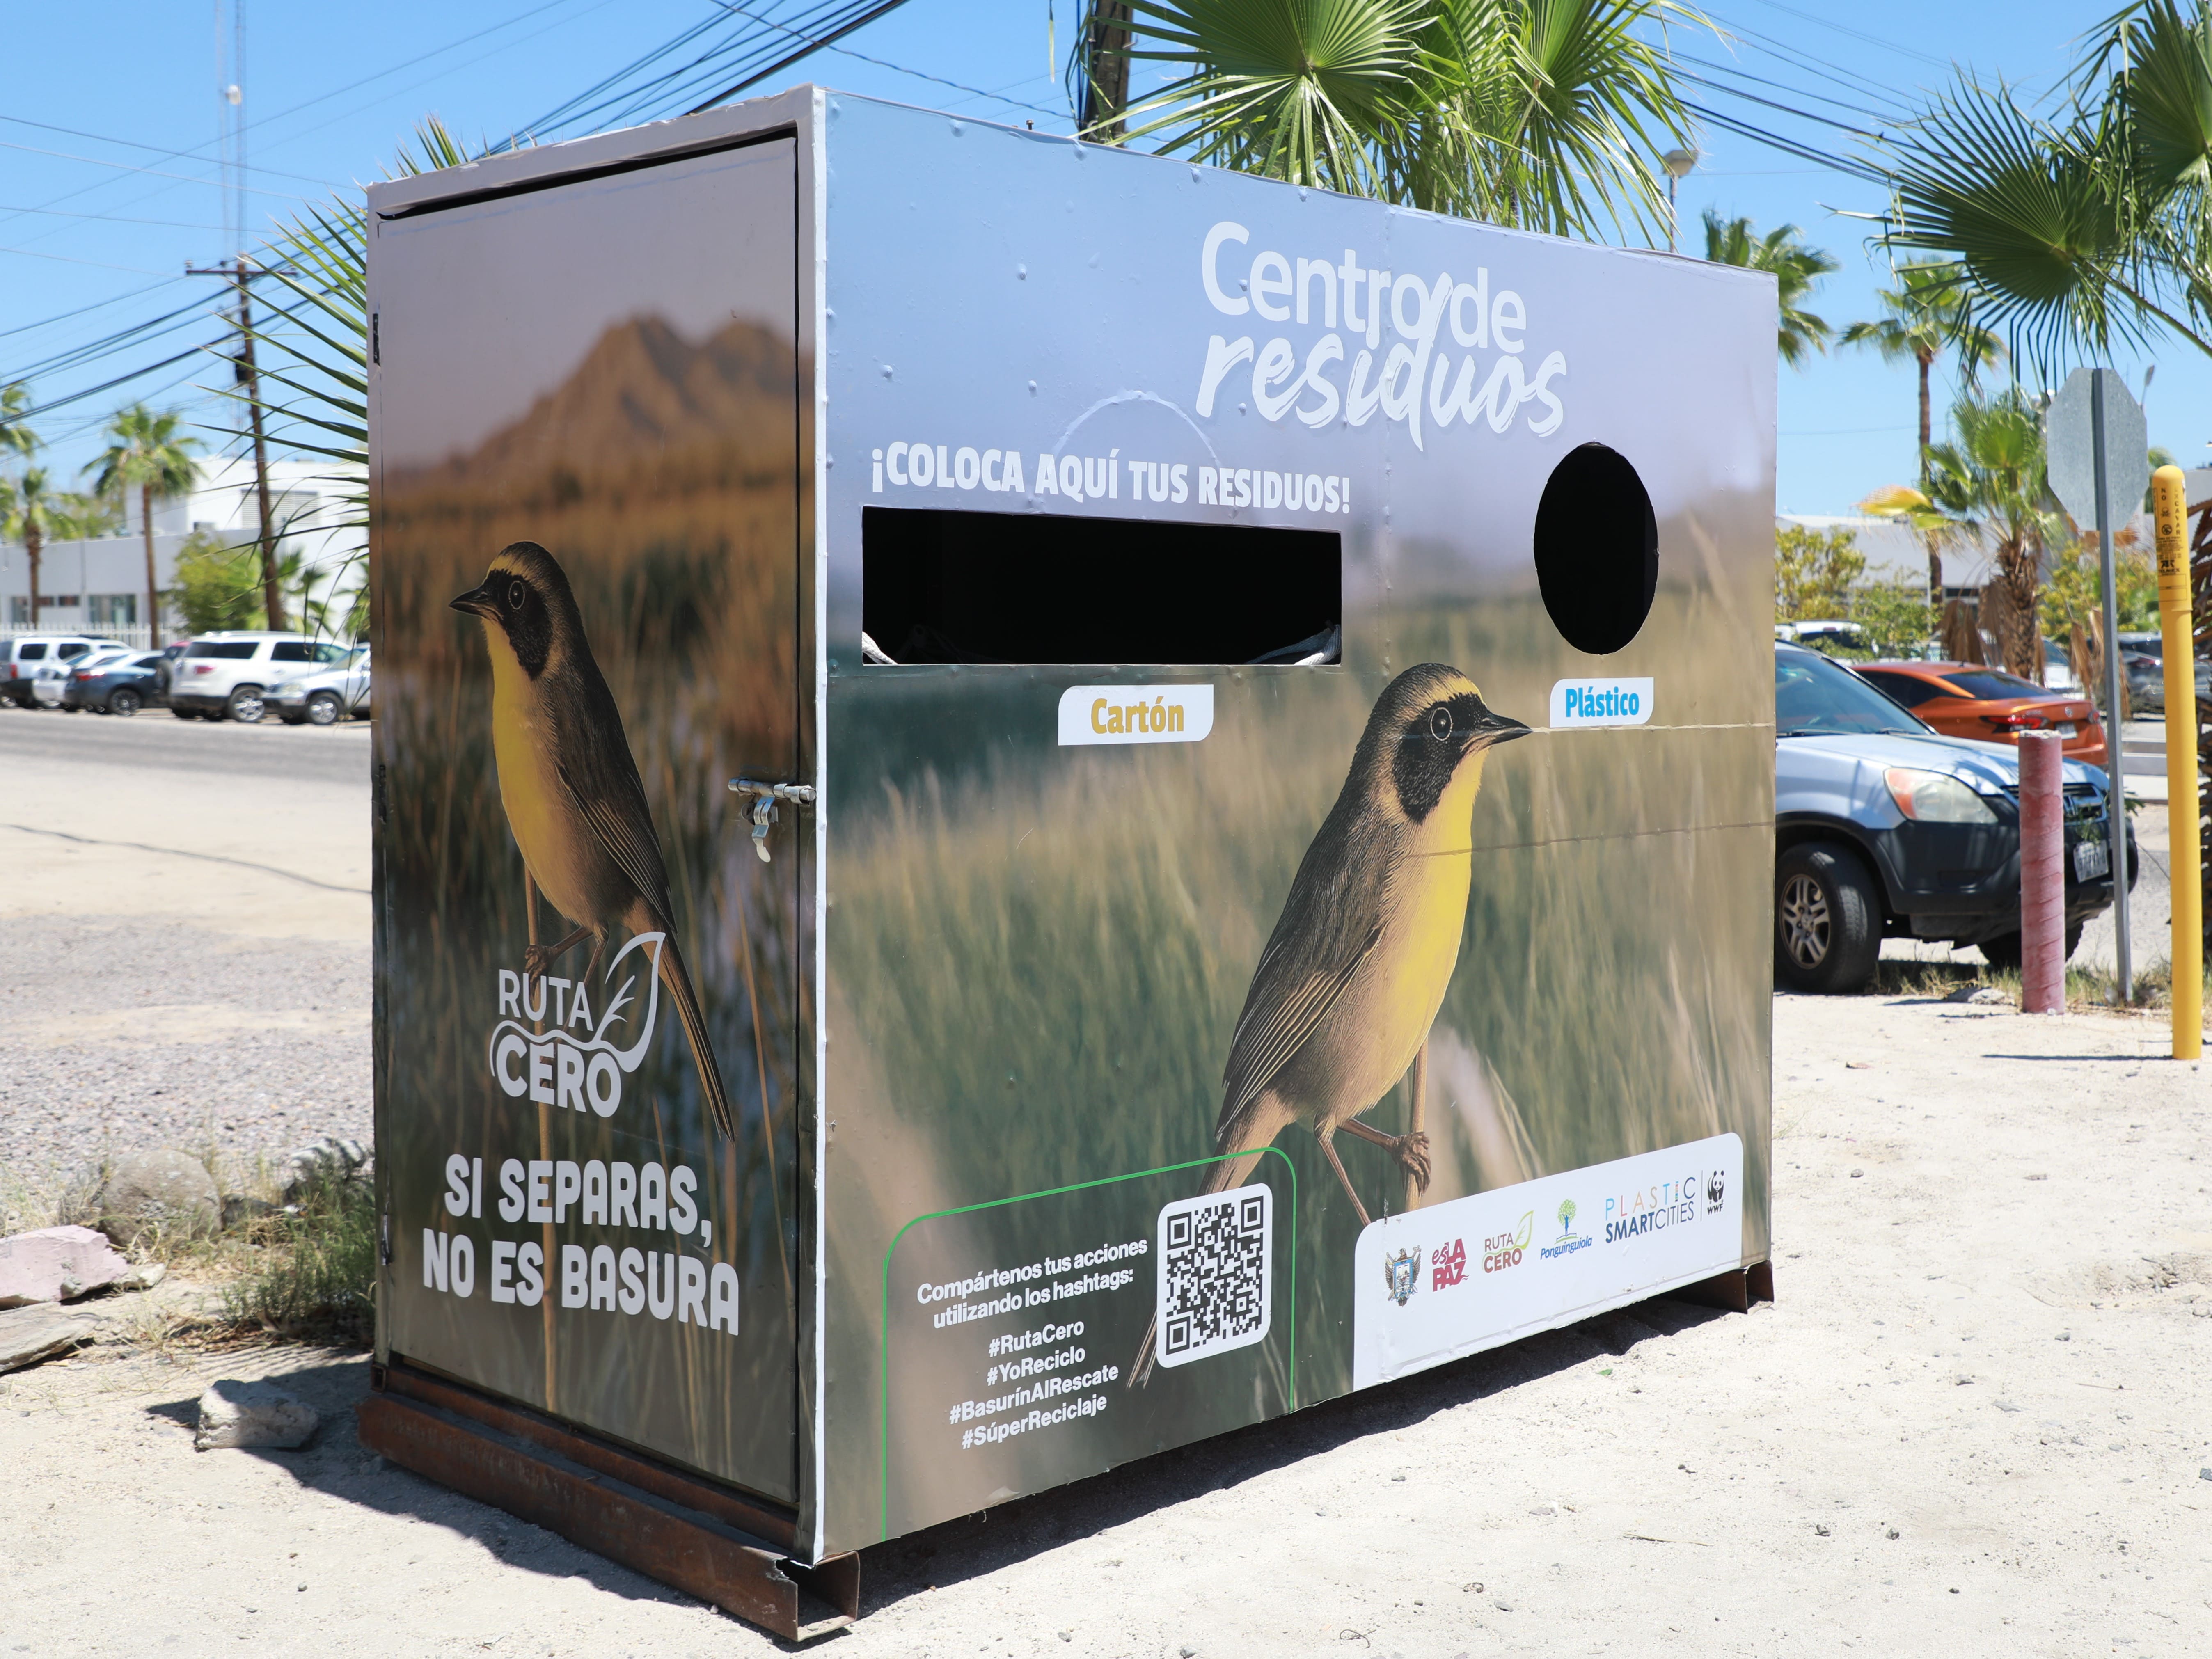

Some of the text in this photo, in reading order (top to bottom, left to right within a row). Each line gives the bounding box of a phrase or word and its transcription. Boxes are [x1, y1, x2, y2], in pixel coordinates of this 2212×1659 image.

[1202, 221, 1527, 353] Centro de
[1195, 272, 1567, 452] residuos
[872, 441, 1351, 514] ¡COLOCA AQUÍ TUS RESIDUOS!
[1091, 697, 1184, 735] Cartón
[1565, 686, 1640, 719] Plástico
[499, 969, 593, 1031] RUTA
[496, 1034, 621, 1118] CERO
[444, 1154, 712, 1248] SI SEPARAS,
[1605, 1177, 1696, 1221] PLASTIC
[1707, 1203, 1724, 1215] WWF
[1484, 1232, 1514, 1252] RUTA
[1484, 1248, 1522, 1273] CERO
[1540, 1235, 1592, 1260] Ponguinguiola
[423, 1228, 739, 1336] NO ES BASURA
[917, 1239, 1148, 1304] Compártenos tus acciones
[1433, 1260, 1469, 1292] PAZ
[933, 1269, 1134, 1329] utilizando los hashtags:
[987, 1346, 1086, 1386] #YoReciclo
[988, 1321, 1085, 1358] #RutaCero
[949, 1364, 1119, 1425] #BasurínAlRescate
[962, 1396, 1107, 1449] #SúperReciclaje
